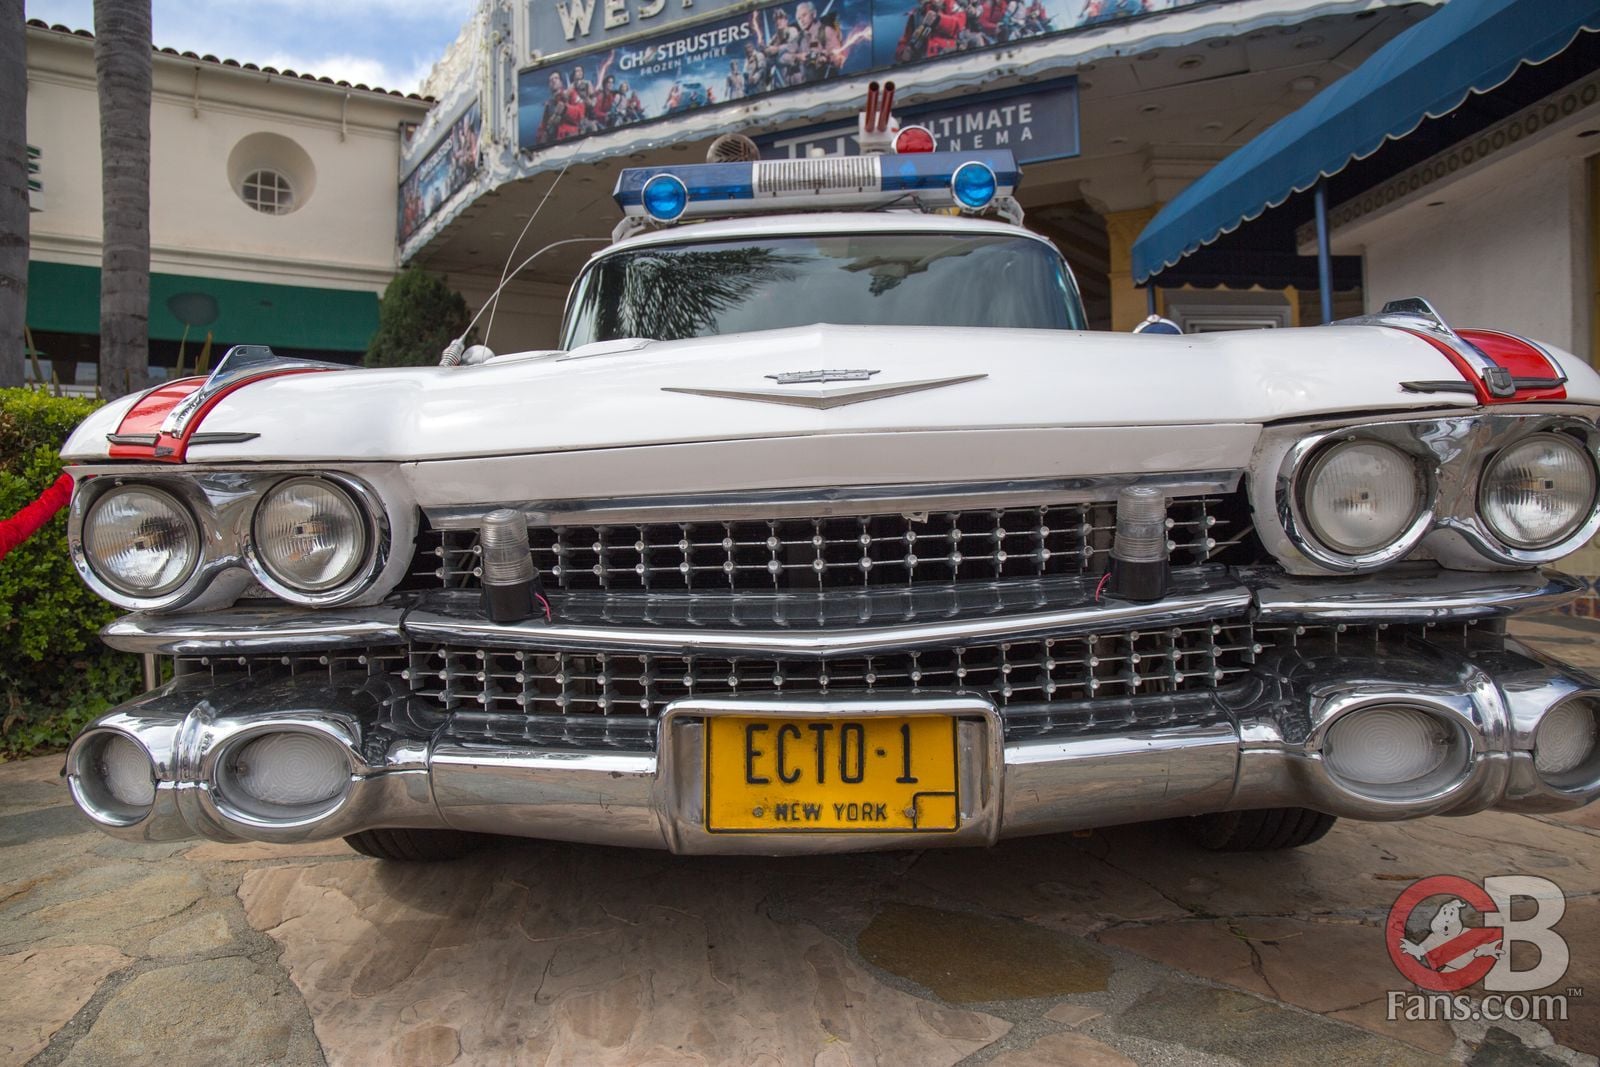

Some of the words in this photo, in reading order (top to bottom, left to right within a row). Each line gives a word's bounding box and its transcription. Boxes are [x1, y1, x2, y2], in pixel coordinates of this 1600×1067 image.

[556, 0, 694, 42] WE
[619, 22, 750, 71] GHOSTBUSTERS
[640, 61, 681, 76] FROZEN
[687, 47, 727, 65] EMPIRE
[920, 103, 1033, 139] LTIMATE
[745, 723, 919, 785] ECTO-1
[774, 803, 822, 821] NEW
[833, 802, 888, 821] YORK
